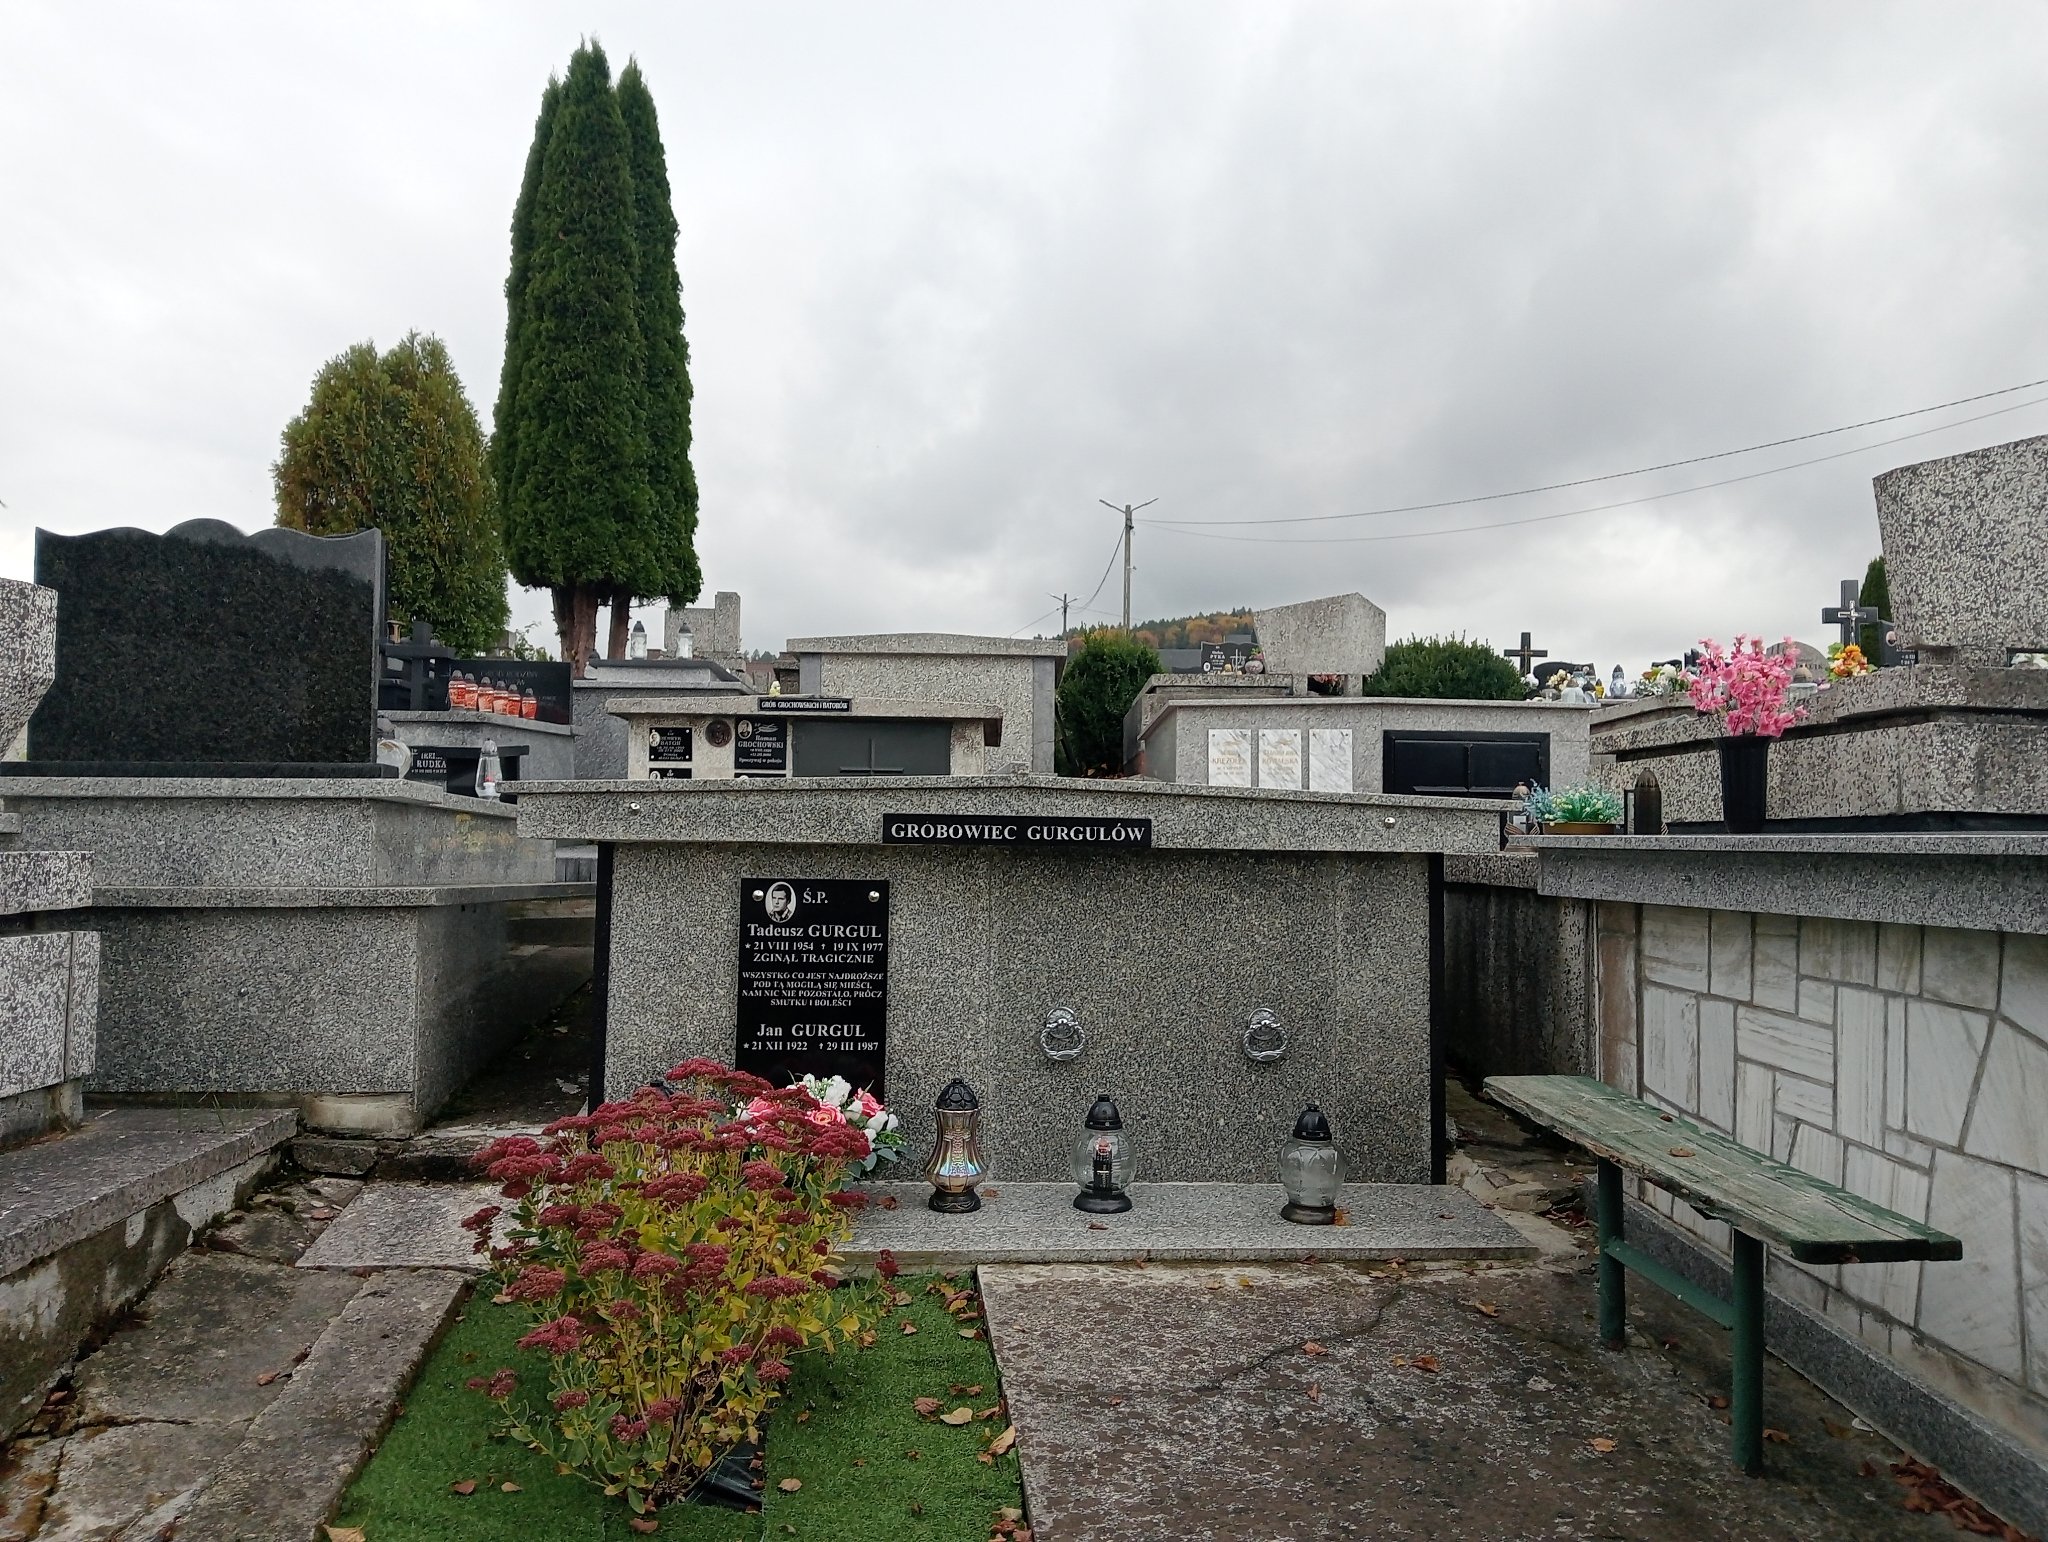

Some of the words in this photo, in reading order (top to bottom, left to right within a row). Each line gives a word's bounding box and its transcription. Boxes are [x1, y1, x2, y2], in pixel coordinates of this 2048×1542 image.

[737, 740, 784, 749] GROCHOWSKI
[416, 760, 447, 769] RUDKA
[891, 822, 1017, 841] GROBOWIEC
[1027, 822, 1145, 841] GURGULÓW
[802, 887, 829, 904] Ś.P.
[747, 923, 804, 937] Tadeusz
[808, 924, 882, 938] GURGUL
[753, 941, 765, 951] 21
[767, 941, 790, 951] VIII
[793, 941, 814, 951] 1954
[833, 942, 844, 952] 19
[846, 942, 859, 952] IX
[862, 942, 884, 952] 1977
[801, 953, 875, 964] TRAGICZNIE
[742, 971, 791, 979] WSZYSTKO
[805, 972, 827, 980] JEST
[828, 971, 885, 981] NAJDROŻSZE
[753, 980, 772, 988] POD
[773, 980, 785, 990] TĄ
[823, 981, 838, 990] SIĘ
[741, 989, 763, 998] NAM
[763, 990, 780, 998] NIC
[781, 990, 797, 998] NIE
[853, 989, 883, 999] PRÓCZ
[770, 998, 809, 1007] SMUTKU
[814, 997, 852, 1007] BOLEŚCI
[756, 1023, 783, 1037] Jan
[791, 1023, 866, 1038] GURGUL
[751, 1041, 762, 1051] 21
[765, 1041, 783, 1051] XII
[786, 1041, 808, 1051] 1922
[826, 1041, 838, 1051] 29
[840, 1041, 854, 1051] III
[857, 1042, 879, 1051] 1987
